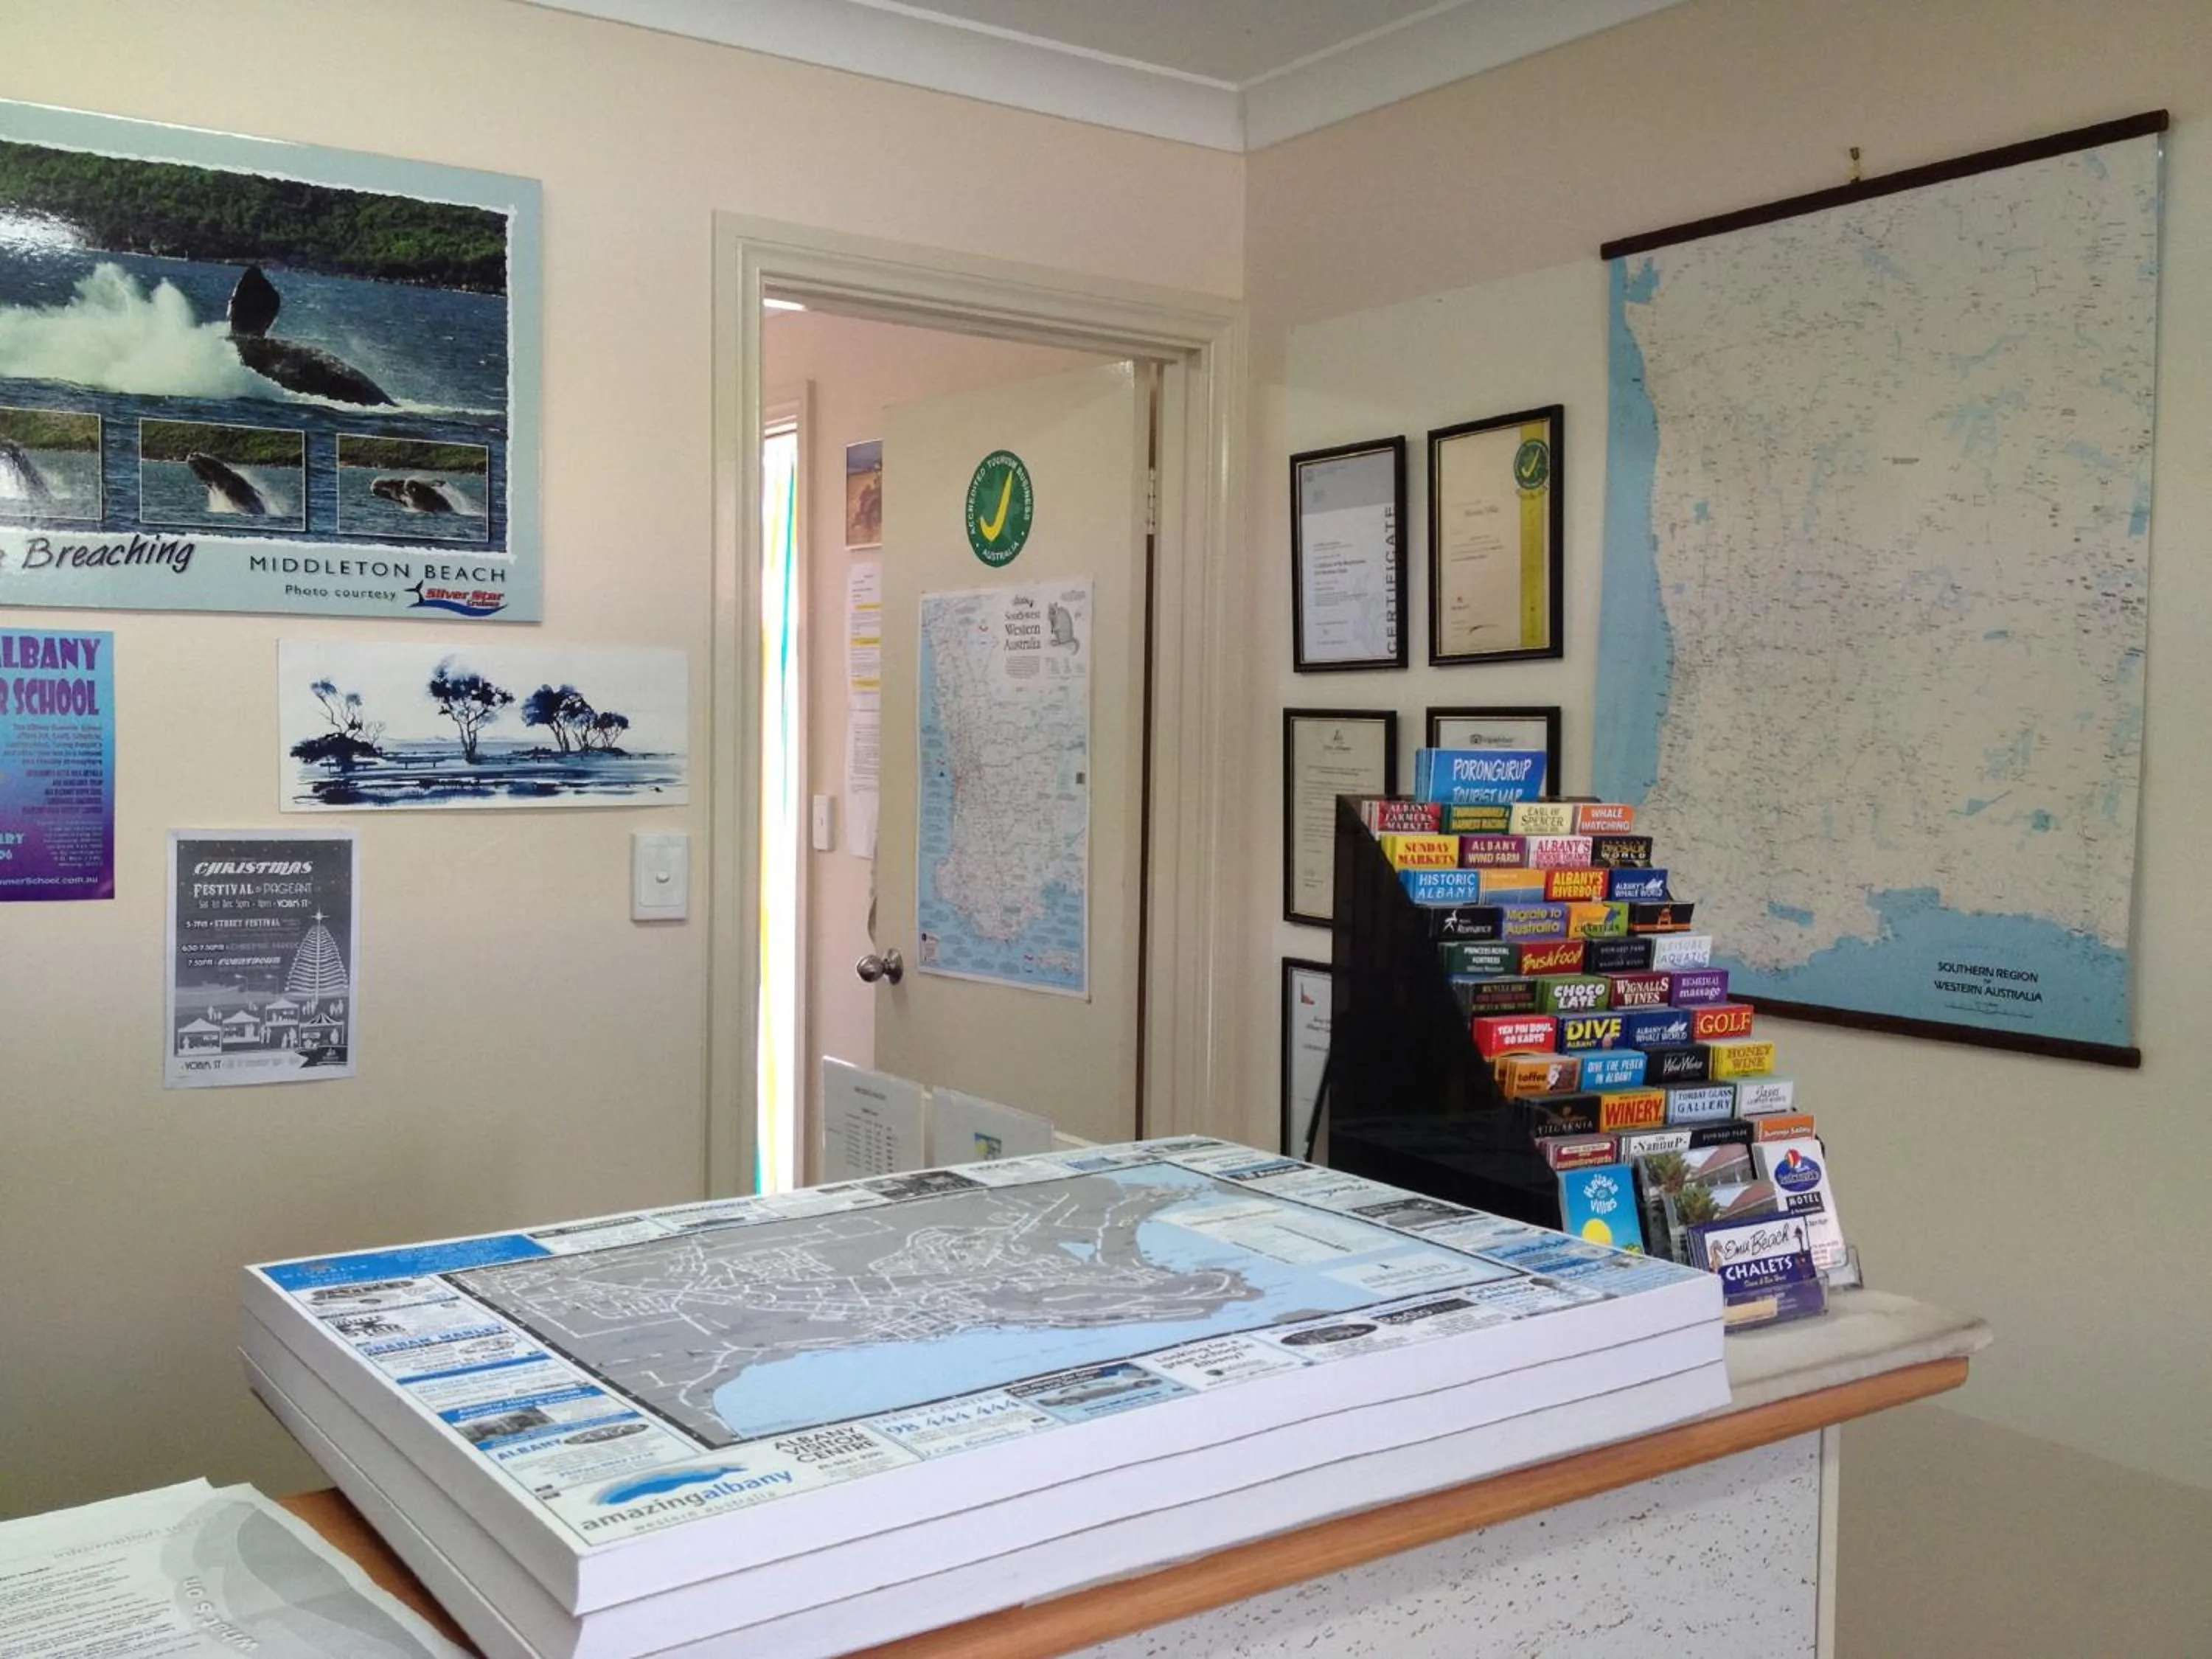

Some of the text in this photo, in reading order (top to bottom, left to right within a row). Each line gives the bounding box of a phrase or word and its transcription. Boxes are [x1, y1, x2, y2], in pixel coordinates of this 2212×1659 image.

[21, 534, 195, 574] Breaching
[981, 541, 1020, 560] AUSTRALIA
[248, 554, 507, 583] MIDDLETON BEACH
[1385, 507, 1397, 655] CERTIFICATE
[285, 585, 397, 601] Photo courtesy
[424, 588, 468, 600] Silver
[1003, 637, 1042, 651] Australia
[0, 636, 101, 670] LBANY
[13, 677, 100, 716] SCHOOL
[1453, 757, 1532, 781] PORONGURUP
[1590, 807, 1624, 818] WHALE
[1521, 815, 1565, 827] SPENCER
[1581, 821, 1630, 832] WATCHING
[1404, 841, 1450, 853] SUNDAY
[1471, 841, 1517, 851] ALBANY
[1537, 839, 1591, 854] ALBANY'S
[1397, 853, 1457, 866] MARKETS
[1467, 852, 1520, 864] WIND FARM
[193, 860, 313, 877] CHRISTMAS
[1419, 873, 1475, 886] HISTORIC
[1553, 871, 1604, 885] ALBANY'S
[193, 883, 254, 898] FESTIVAL
[1416, 886, 1475, 899] ALBANY
[1552, 886, 1603, 898] RIVERBOAT
[1937, 961, 2039, 983] SOUTHERN REGION
[1615, 976, 1670, 994] WIGNALLS
[1681, 976, 1719, 987] REMEDIAL
[1554, 983, 1606, 997] CHOCO
[1679, 987, 1722, 1000] massage
[1934, 980, 2043, 1004] WESTERN AUSTRALIA
[1558, 995, 1596, 1009] LATE
[1624, 992, 1660, 1005] WINES
[1497, 1025, 1514, 1034] TEN
[1515, 1024, 1528, 1033] PIN
[1565, 1018, 1621, 1041] DIVE
[1700, 1012, 1752, 1034] GOLF
[1516, 1034, 1545, 1043] KARTS
[1727, 1043, 1773, 1059] HONEY
[1587, 1060, 1602, 1073] DIVE
[1731, 1057, 1766, 1069] WINE
[1595, 1071, 1632, 1085] IN ALBANY
[1708, 1088, 1733, 1099] GLASS
[1677, 1099, 1731, 1114] GALLERY
[1788, 1192, 1820, 1206] MOTEL
[1750, 1223, 1790, 1256] Beach
[1725, 1256, 1793, 1281] CHALETS
[774, 1426, 857, 1450] ALBANY
[783, 1433, 869, 1455] VISITOR
[498, 1437, 562, 1461] ALBANY
[796, 1441, 880, 1464] CENTRE
